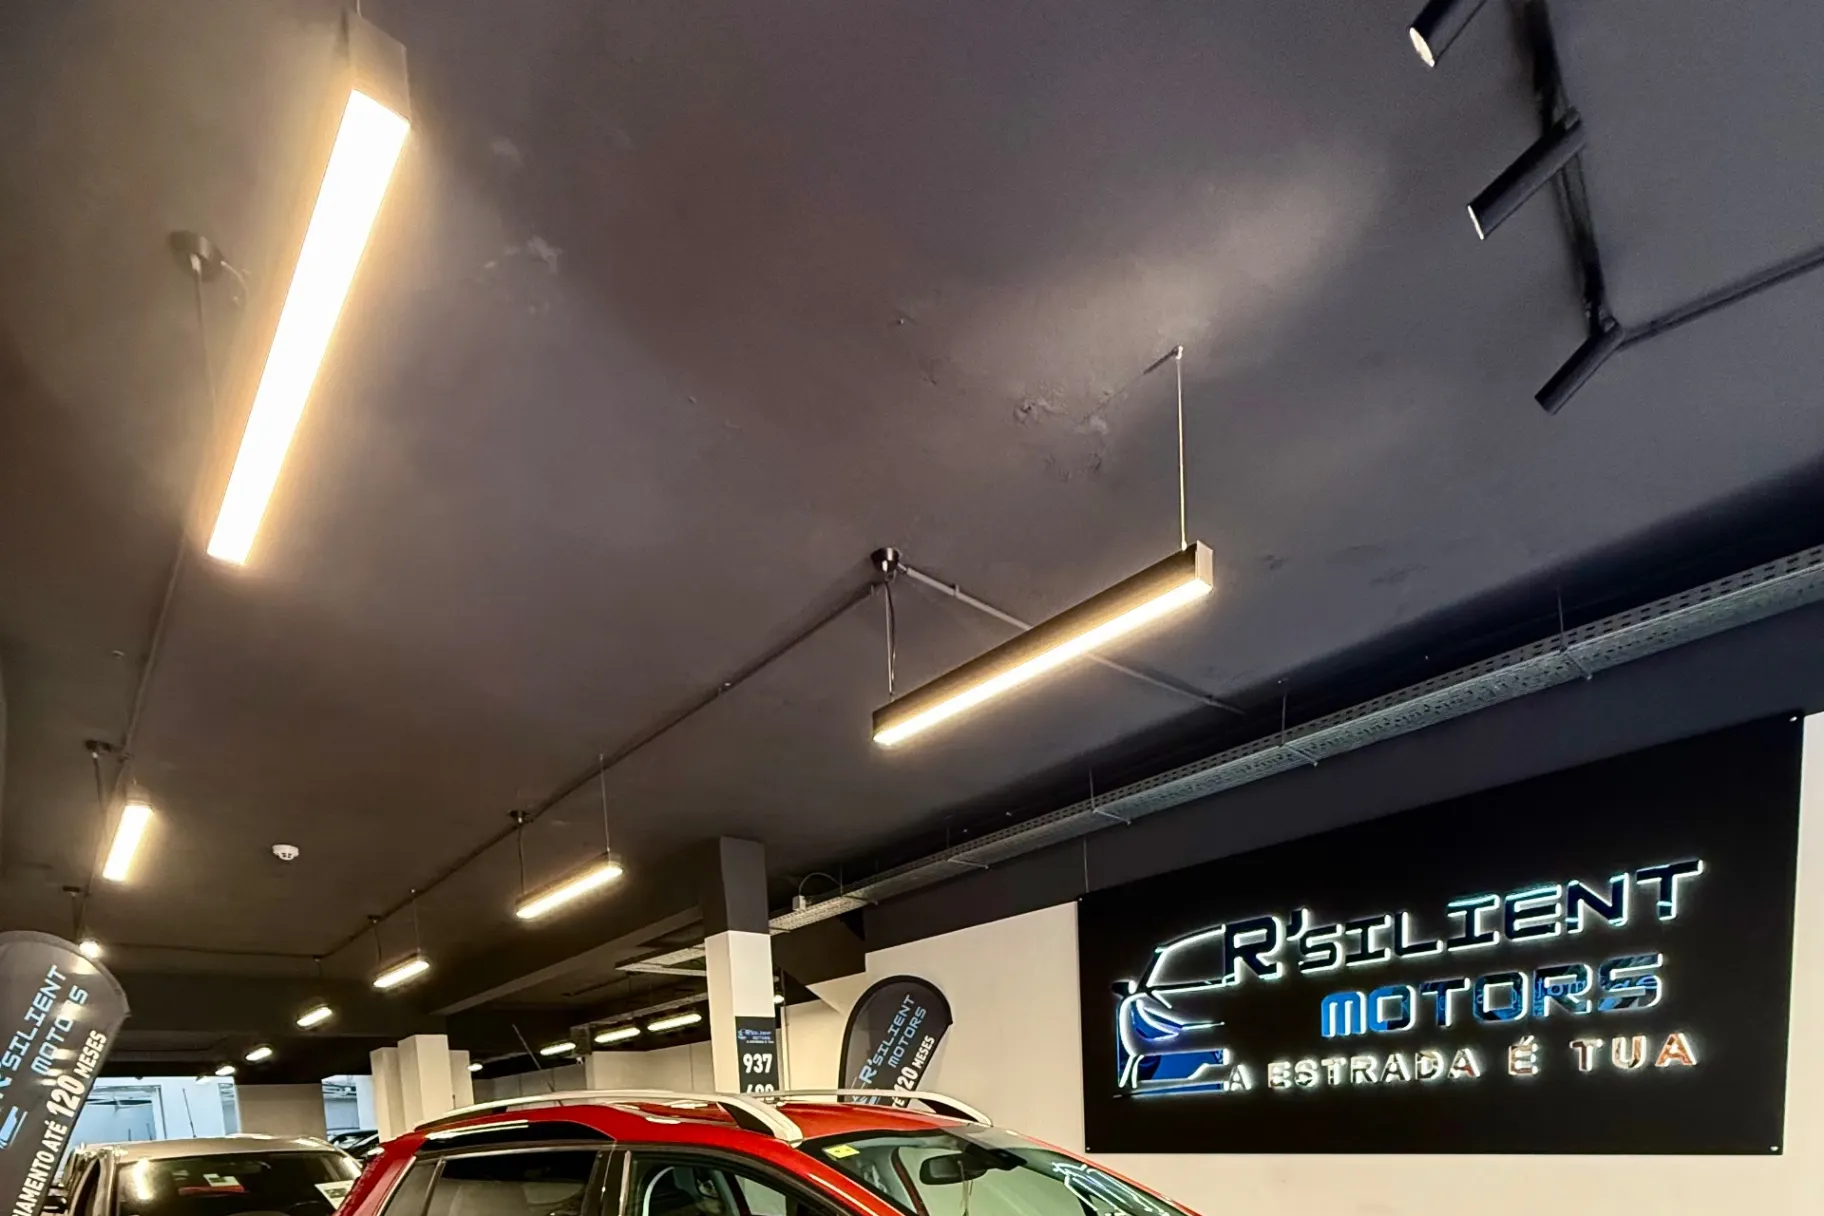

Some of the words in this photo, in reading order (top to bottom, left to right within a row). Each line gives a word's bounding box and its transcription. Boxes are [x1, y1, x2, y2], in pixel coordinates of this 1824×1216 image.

[1224, 858, 1704, 986] R'SILIENT
[1320, 952, 1664, 1038] MOTORS
[31, 985, 89, 1077] MOTOS
[73, 1029, 108, 1079] MESES
[859, 994, 915, 1084] R'SILIENT
[888, 1006, 927, 1068] MOTORS
[912, 1035, 935, 1069] MESES
[1225, 1064, 1252, 1091] A
[1267, 1046, 1481, 1089] ESTRADA
[1507, 1034, 1539, 1076] É
[1569, 1031, 1698, 1073] TUA
[743, 1053, 773, 1074] 937
[46, 1074, 85, 1118] 120
[42, 1120, 69, 1153] ATÉ
